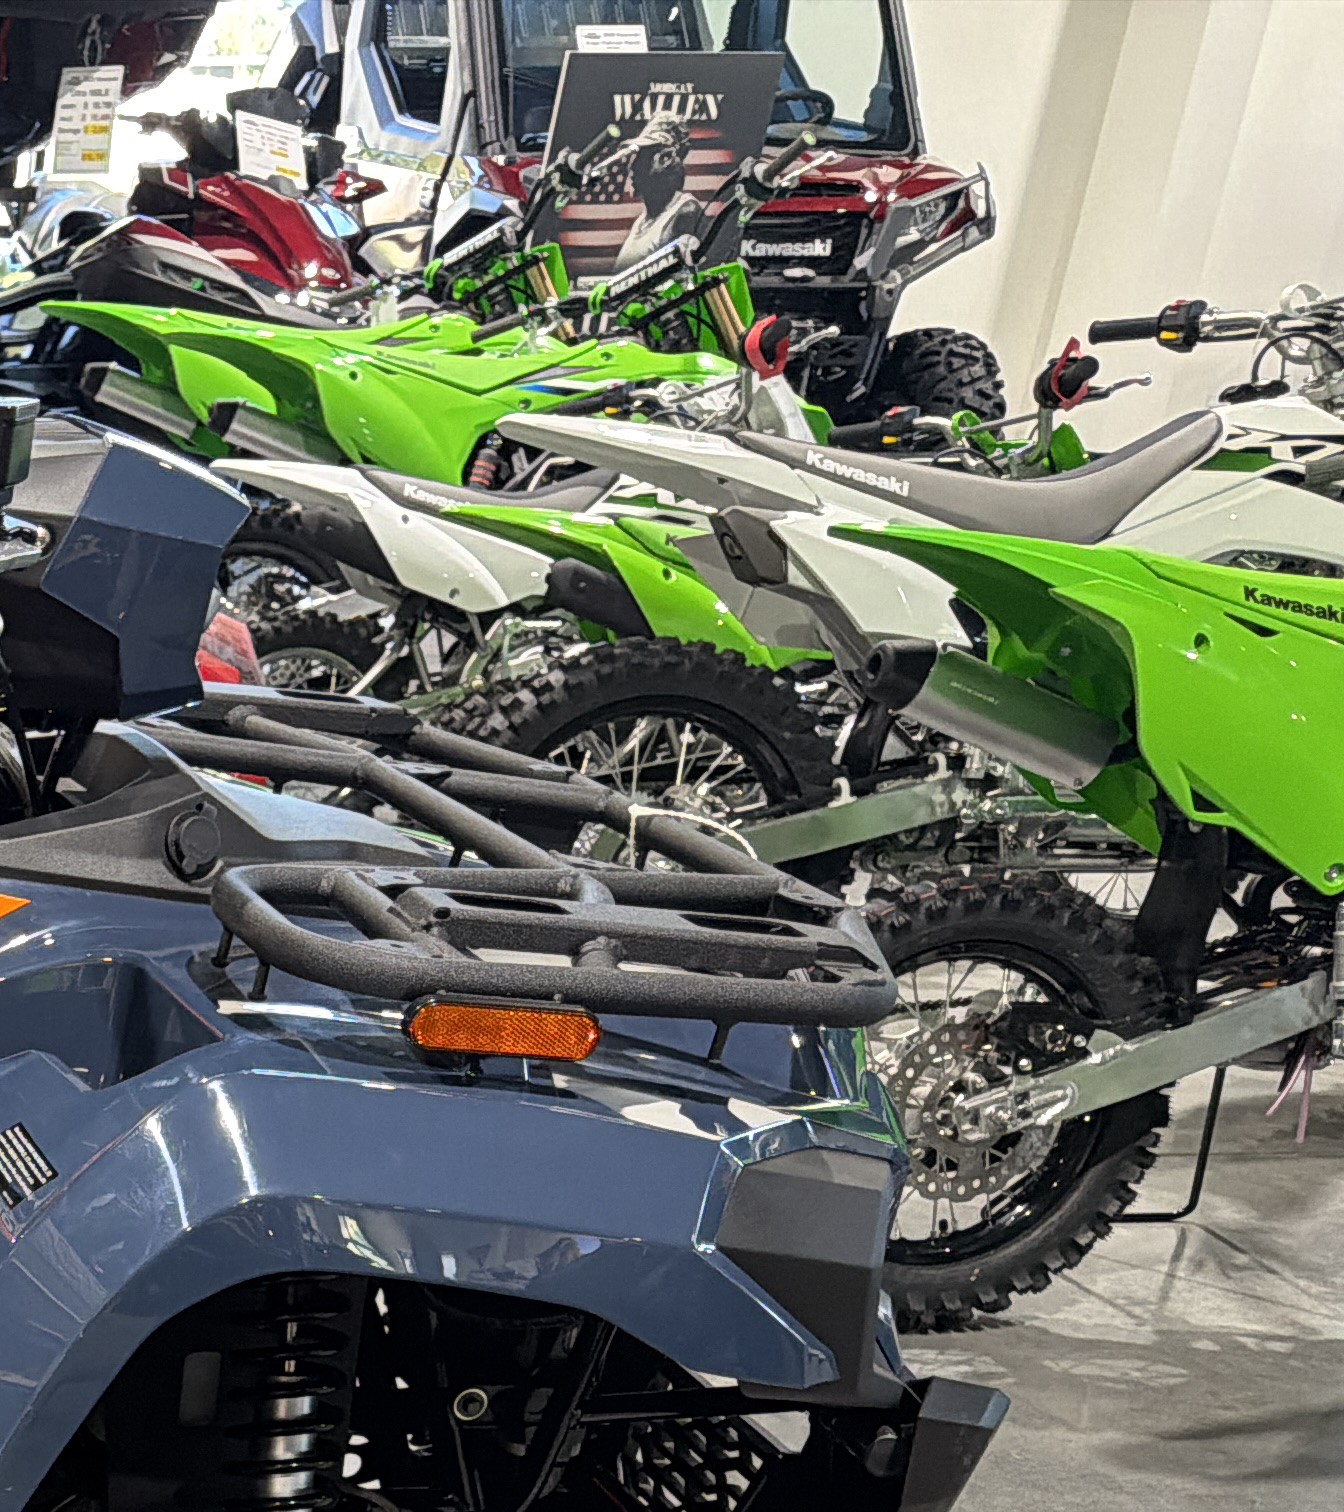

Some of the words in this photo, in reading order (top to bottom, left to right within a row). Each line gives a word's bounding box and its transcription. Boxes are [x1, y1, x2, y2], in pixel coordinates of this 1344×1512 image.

[613, 93, 724, 121] WALLEN
[740, 239, 832, 258] Kawasaki
[610, 253, 678, 297] RENTHAL
[806, 449, 910, 497] Kawasaki
[1243, 585, 1344, 625] Kawasaki
